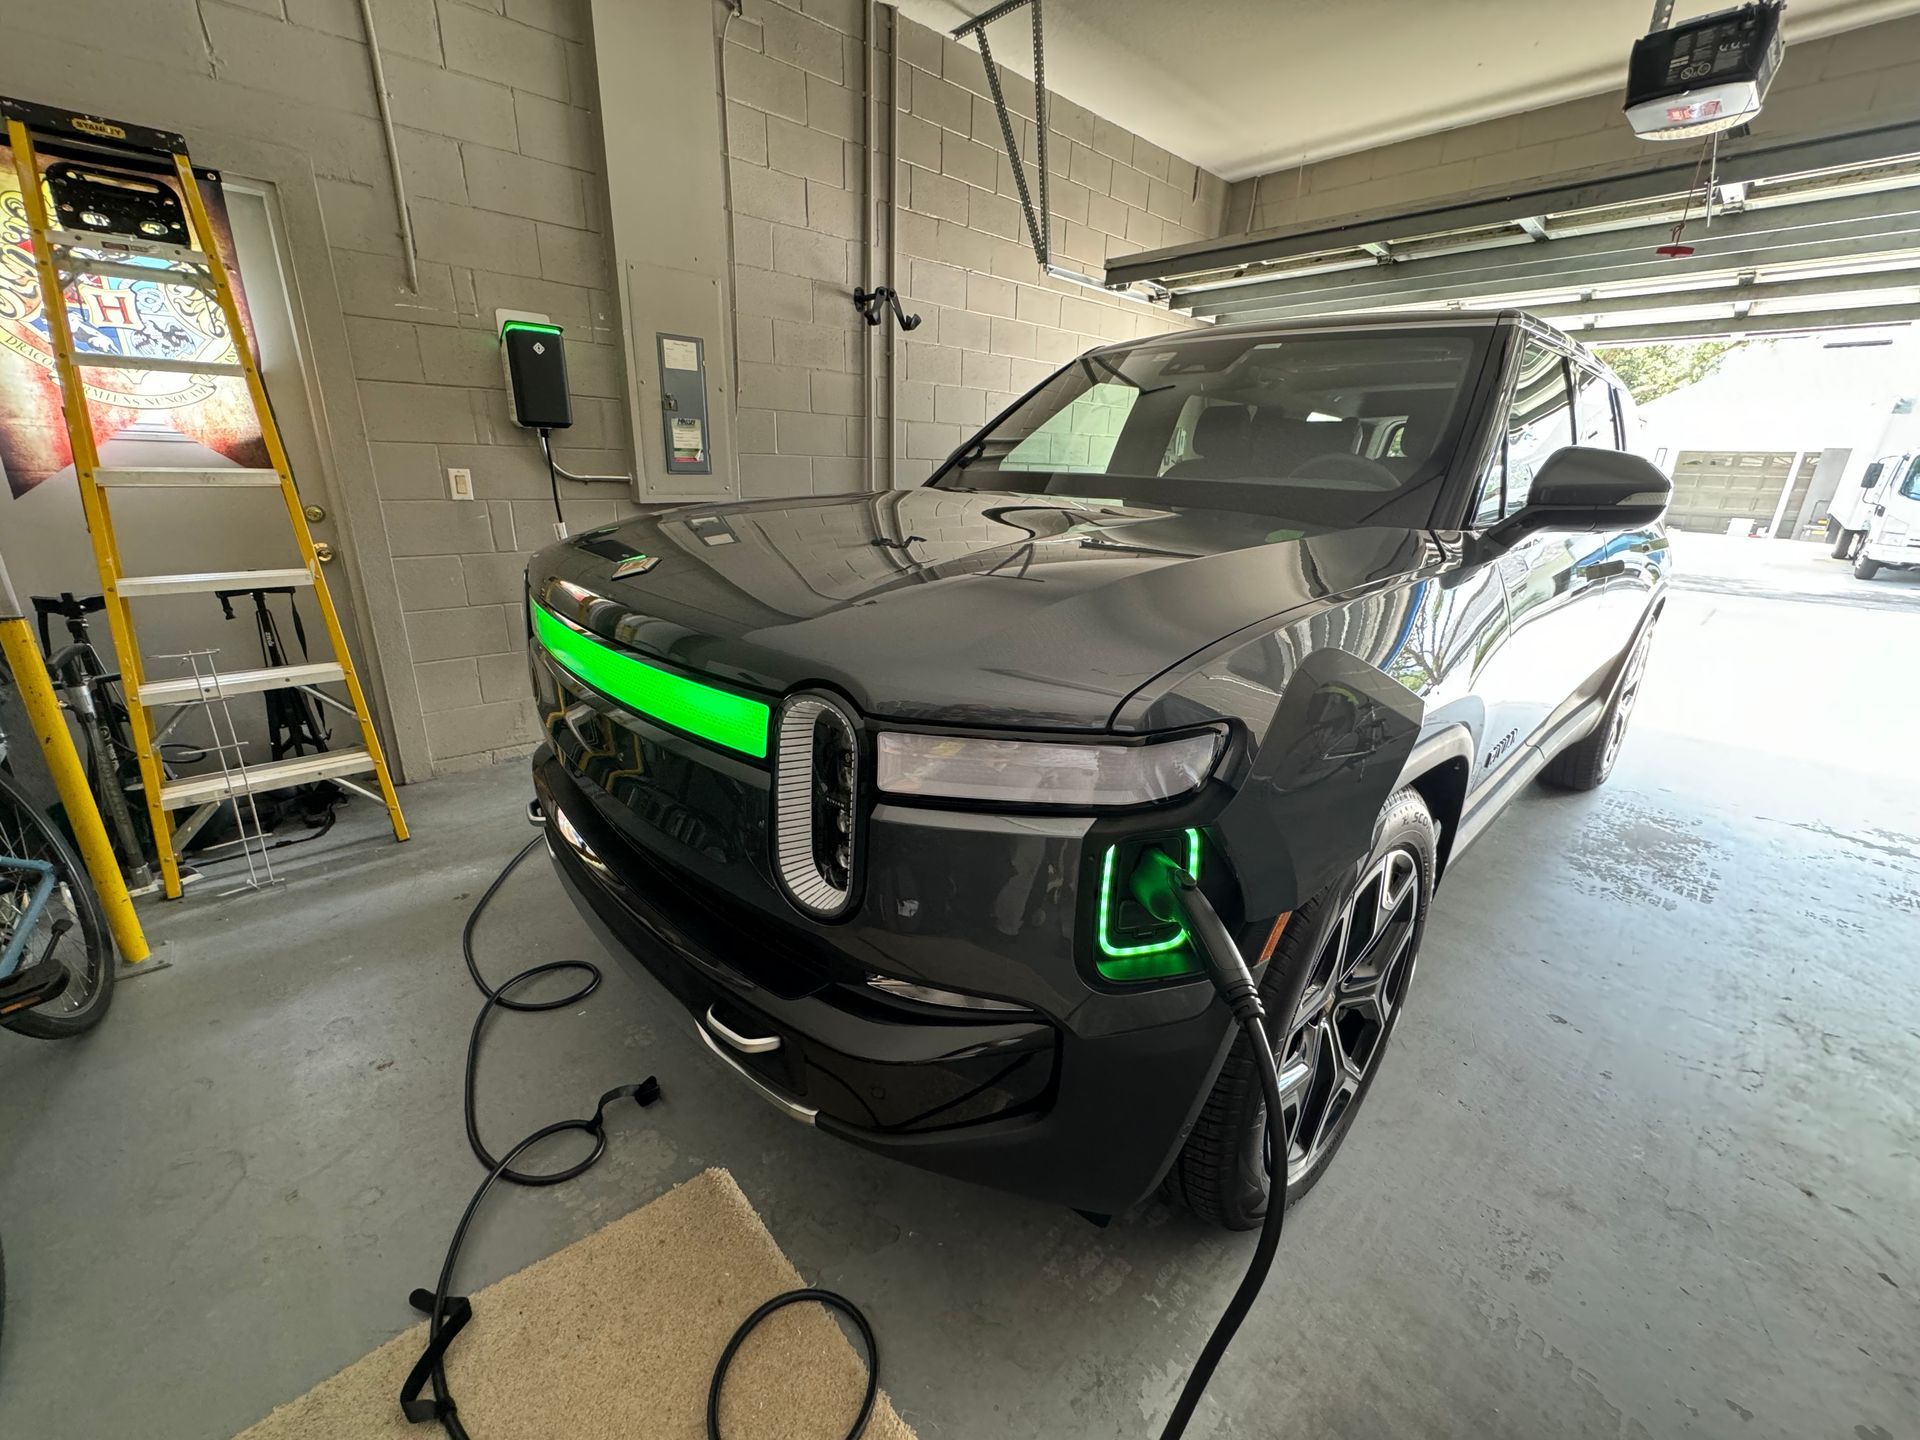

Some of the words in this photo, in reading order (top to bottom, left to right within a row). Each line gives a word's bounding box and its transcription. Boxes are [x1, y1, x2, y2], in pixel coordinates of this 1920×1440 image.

[91, 294, 133, 324] H
[5, 336, 53, 366] DRACO
[83, 385, 140, 405] RMIENS
